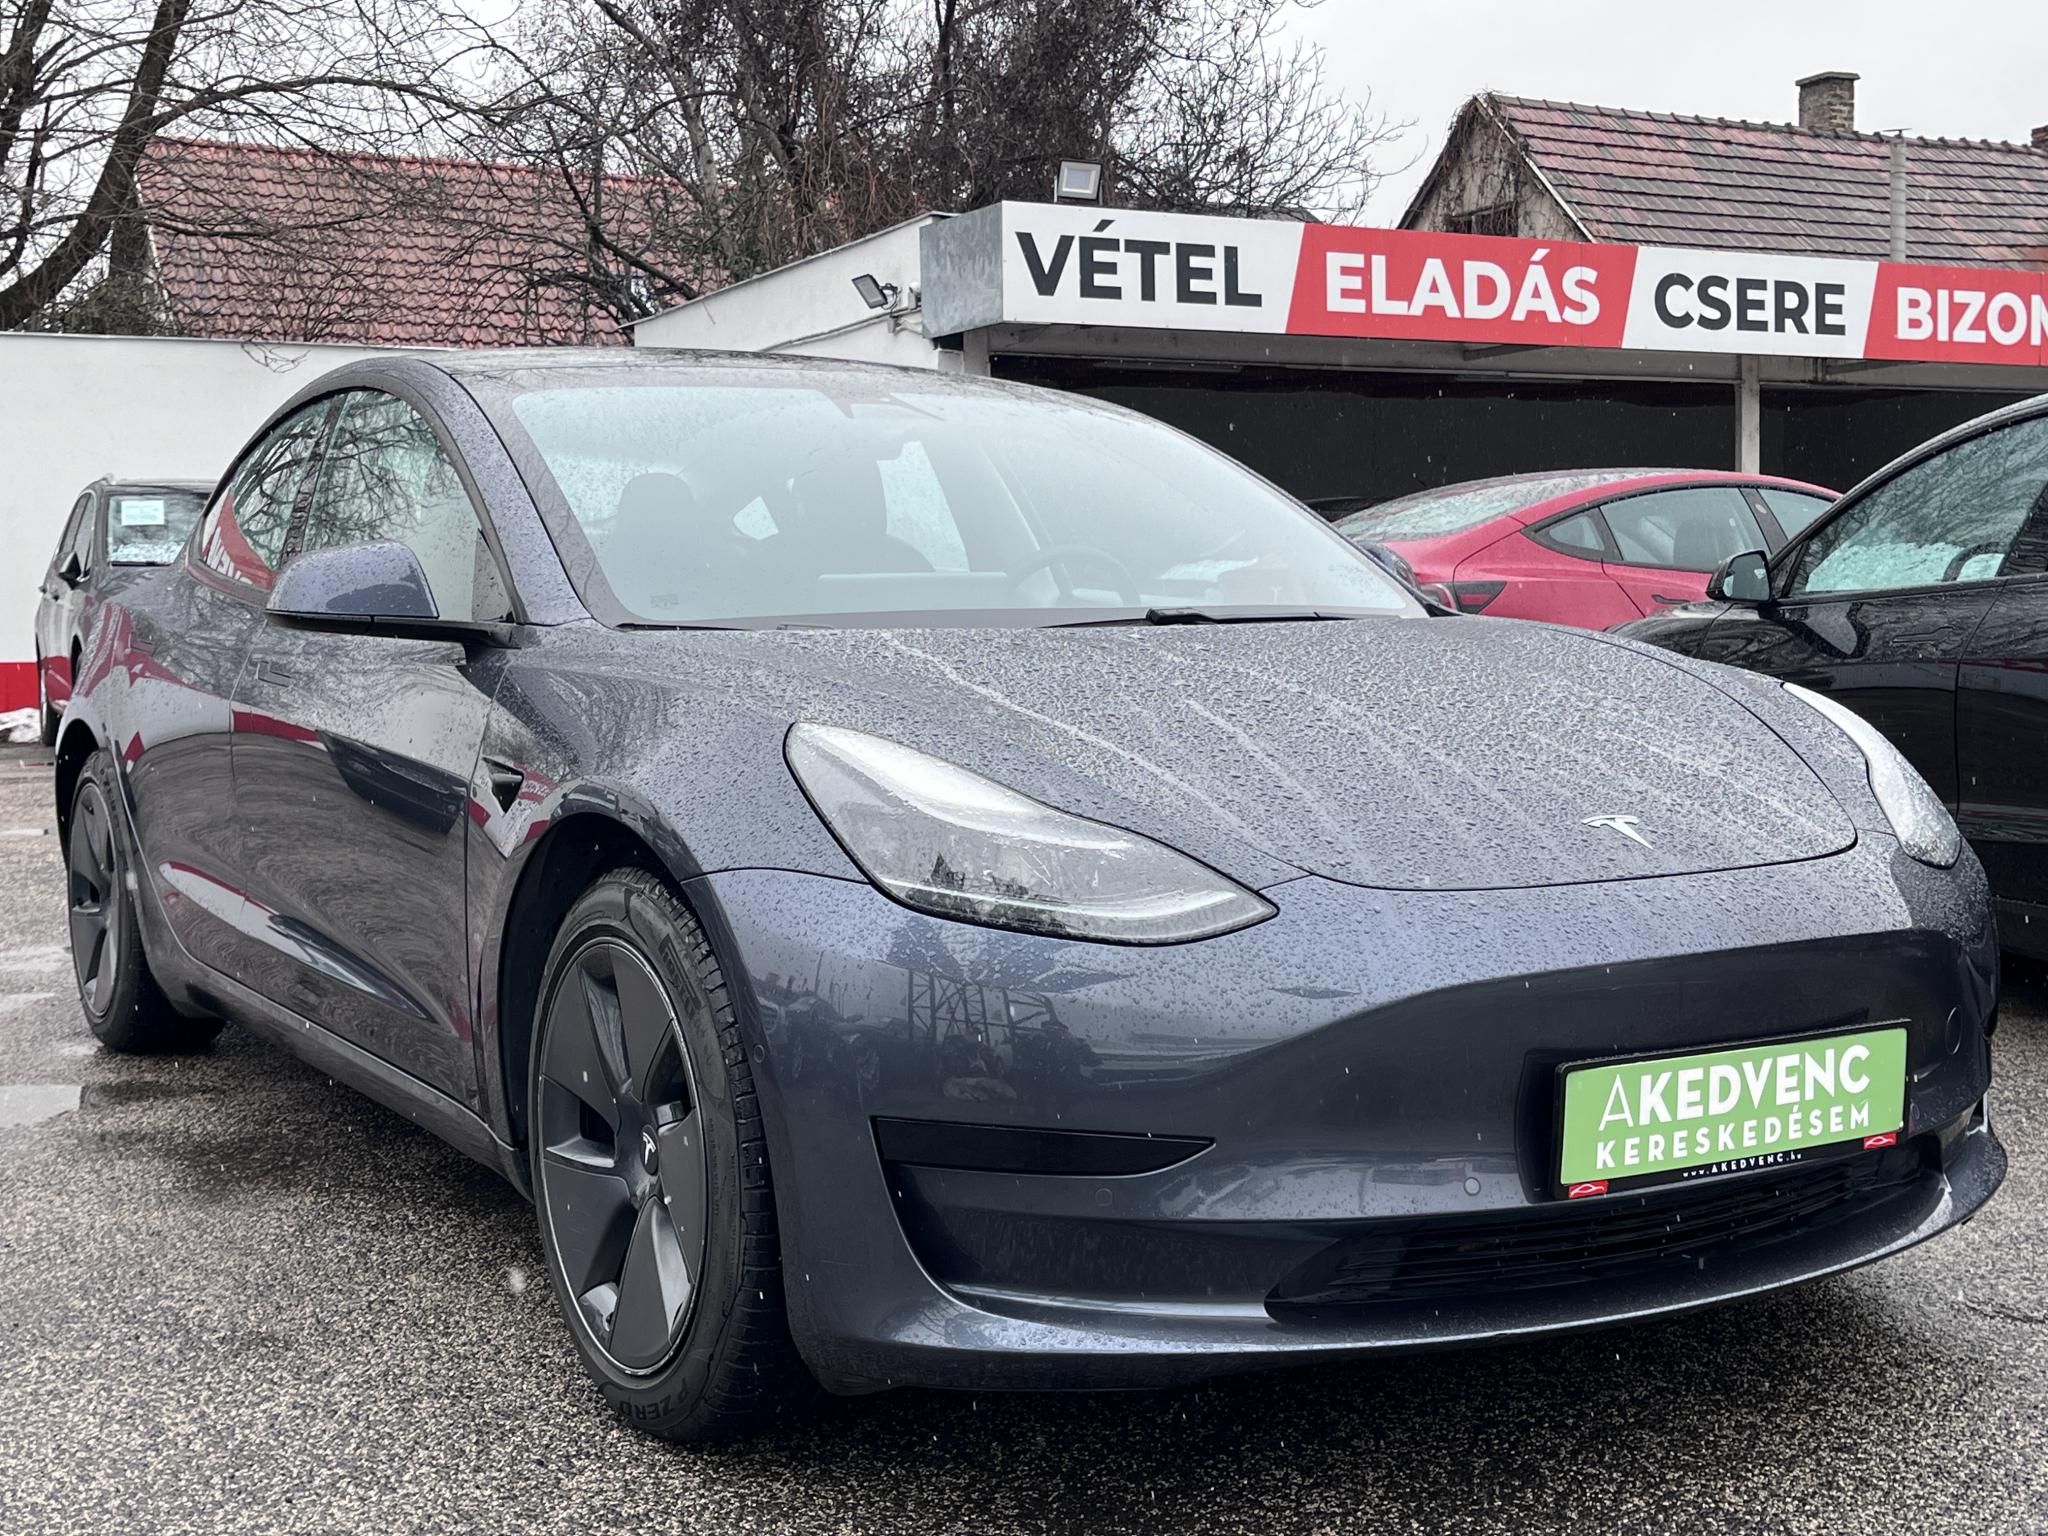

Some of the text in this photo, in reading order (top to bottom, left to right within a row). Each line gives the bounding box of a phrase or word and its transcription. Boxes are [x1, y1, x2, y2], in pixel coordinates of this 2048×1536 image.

[1017, 220, 1263, 308] VÉTEL
[1325, 247, 1601, 326] ELADÁS
[1654, 273, 1847, 337] CSERE
[1596, 1102, 1870, 1170] KERESKEDÉSEM
